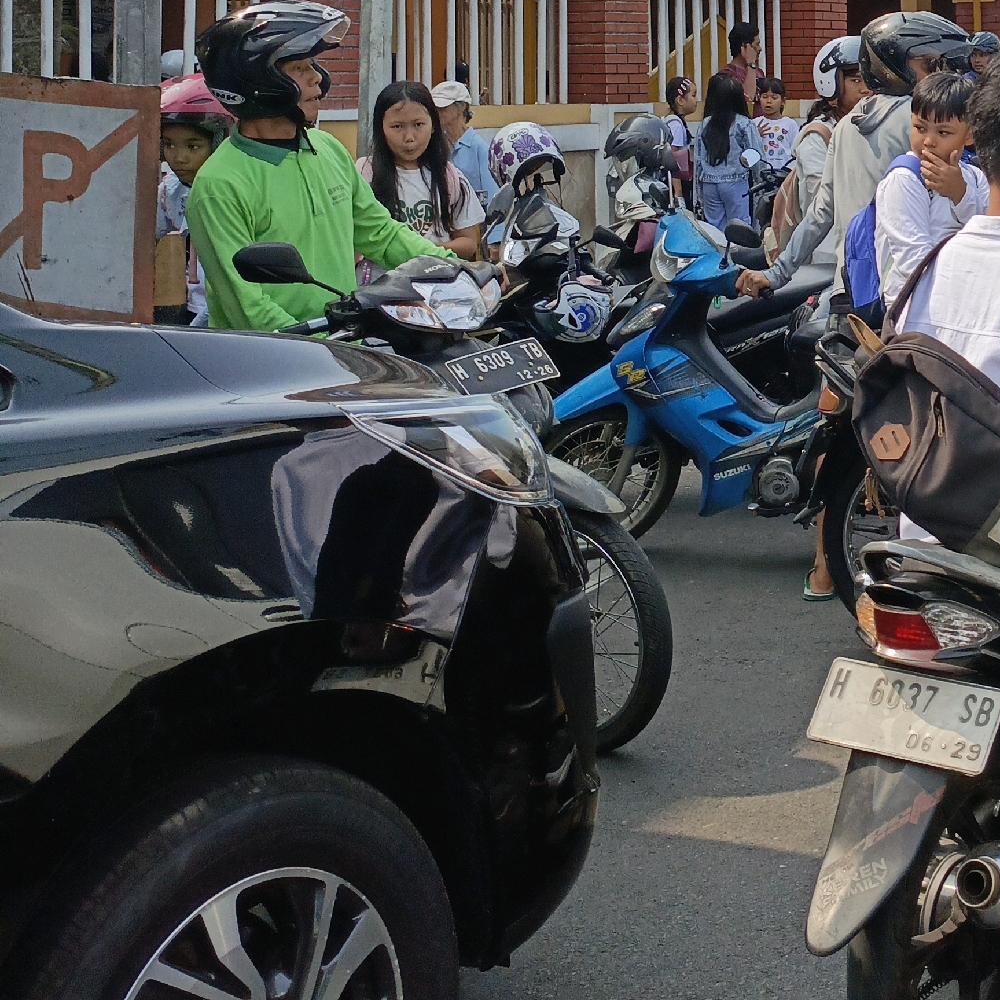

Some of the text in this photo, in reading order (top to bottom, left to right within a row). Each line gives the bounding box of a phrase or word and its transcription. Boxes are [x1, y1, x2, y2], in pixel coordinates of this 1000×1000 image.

[450, 342, 543, 380] H 6309 TB
[713, 463, 752, 481] SUZUKI
[829, 667, 995, 727] H 6037 SB
